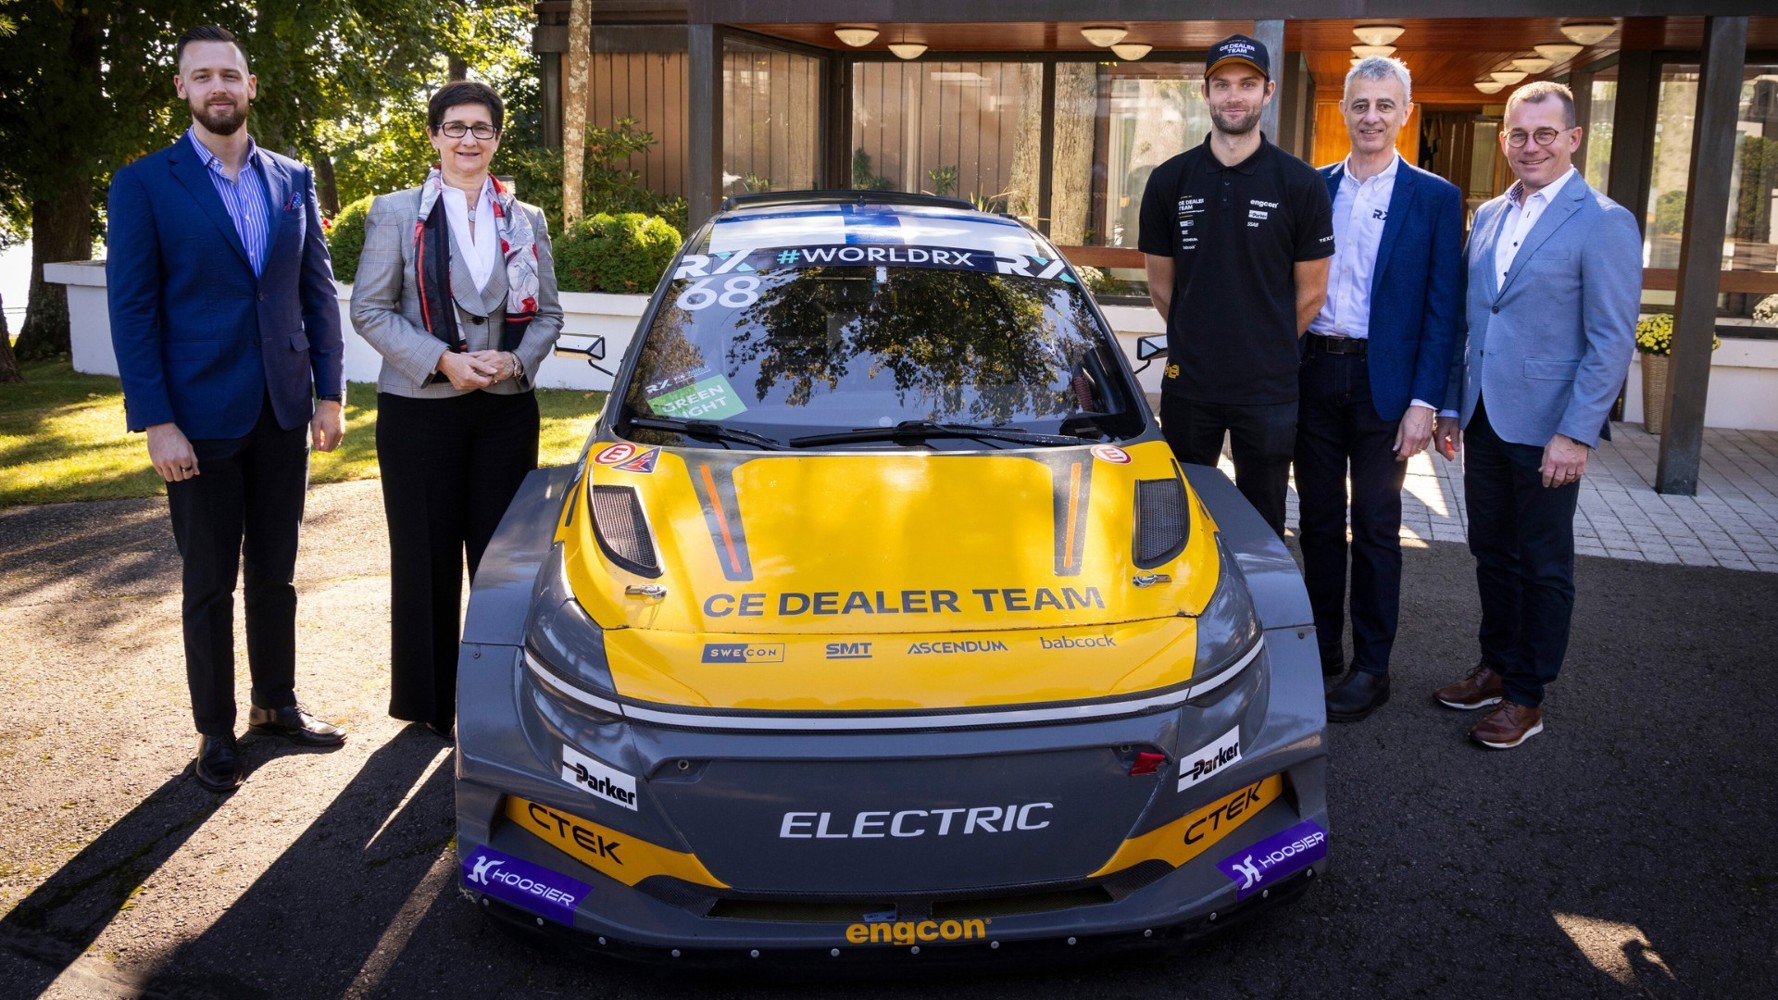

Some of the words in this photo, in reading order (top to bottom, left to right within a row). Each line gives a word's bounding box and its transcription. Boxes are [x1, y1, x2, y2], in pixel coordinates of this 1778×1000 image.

[1229, 43, 1255, 51] DEALER
[776, 247, 975, 267] #WORLDRX
[676, 275, 761, 311] 68
[661, 384, 725, 413] GREEN
[681, 396, 727, 419] IGHT
[703, 592, 767, 618] CE
[777, 589, 962, 616] DEALER
[973, 586, 1105, 612] TEAM
[709, 648, 777, 658] SWECON
[825, 642, 872, 655] SMT
[907, 640, 1008, 655] ASCENDUM
[1040, 634, 1117, 650] babcock
[1192, 742, 1240, 782] Parker
[574, 762, 636, 806] Parker
[779, 802, 1054, 839] ELECTRIC
[1183, 779, 1262, 846] CTEK
[527, 801, 624, 866] CTEK
[1258, 831, 1325, 868] HOOSIER
[492, 868, 576, 907] HOOSIER
